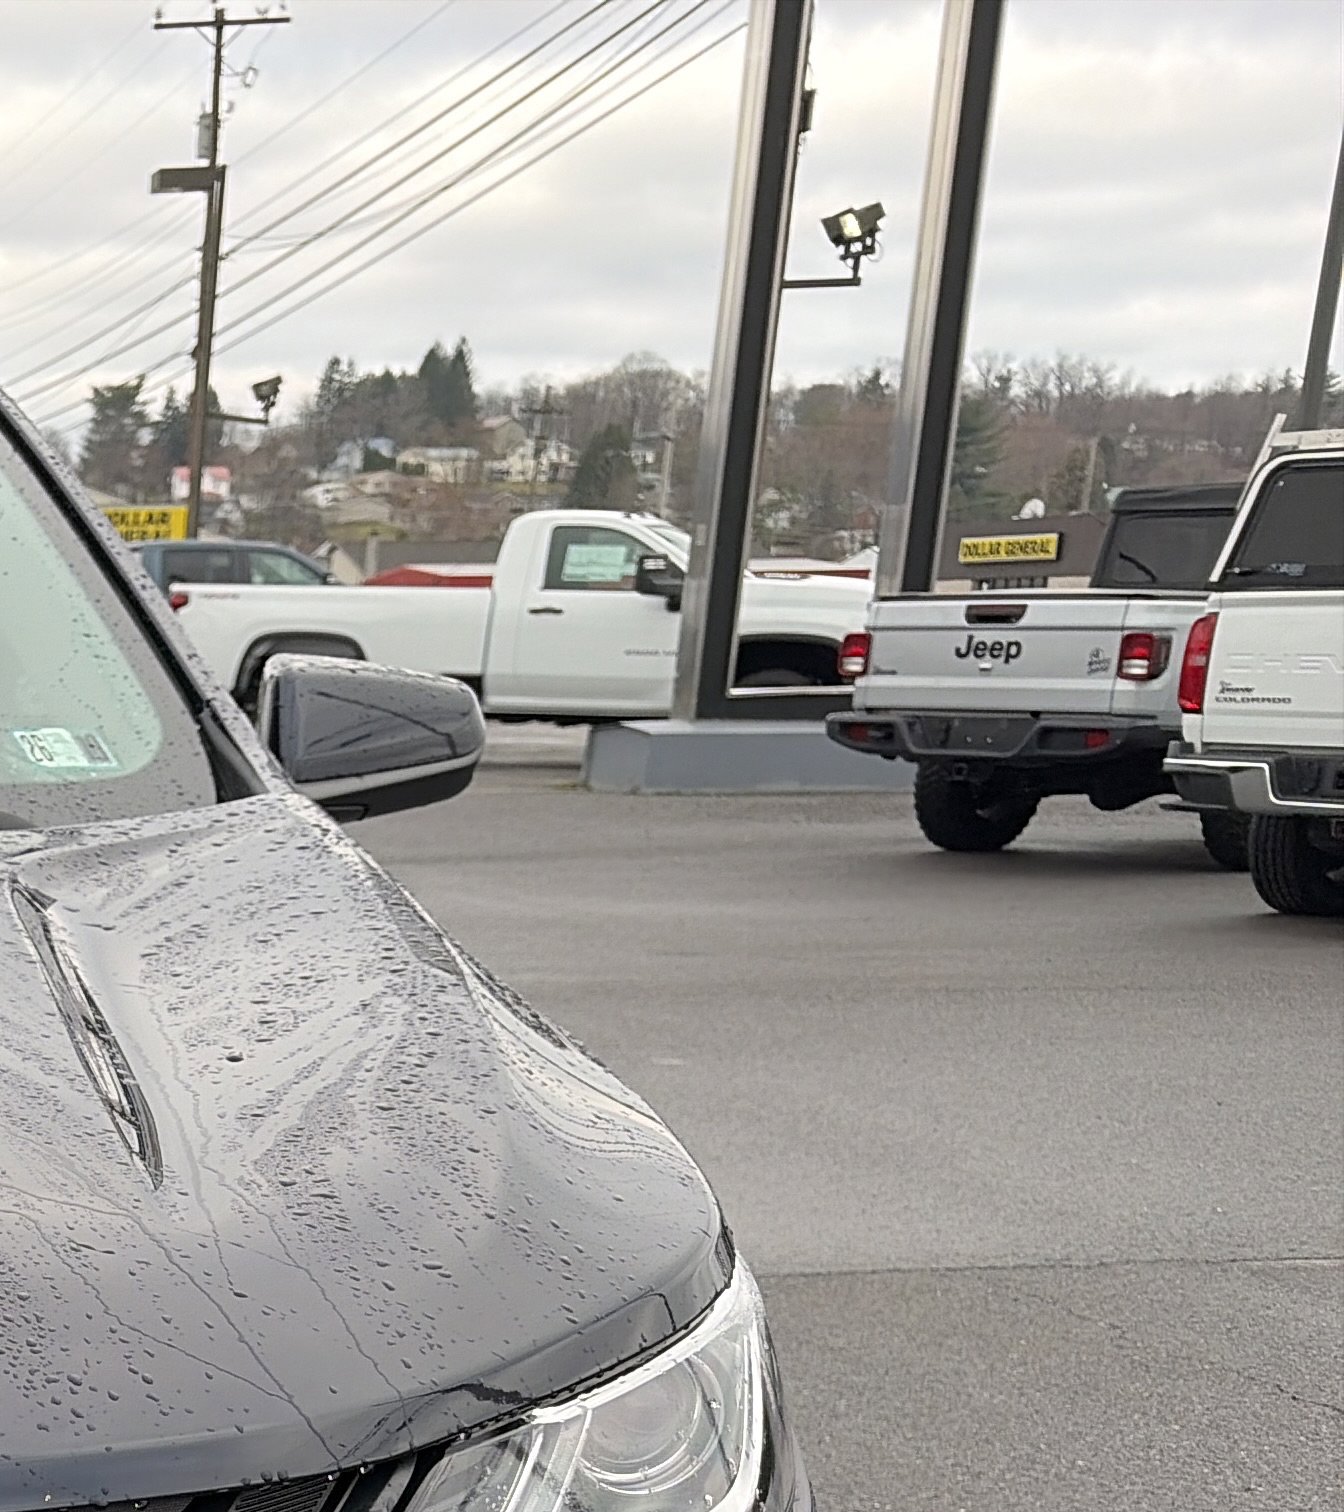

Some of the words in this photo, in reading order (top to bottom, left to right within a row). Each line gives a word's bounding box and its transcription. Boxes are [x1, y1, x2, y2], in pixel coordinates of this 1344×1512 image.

[962, 541, 1001, 557] DOLLAR
[954, 634, 1023, 664] Jeep
[1214, 696, 1292, 704] COLORADO
[19, 734, 55, 762] 26
